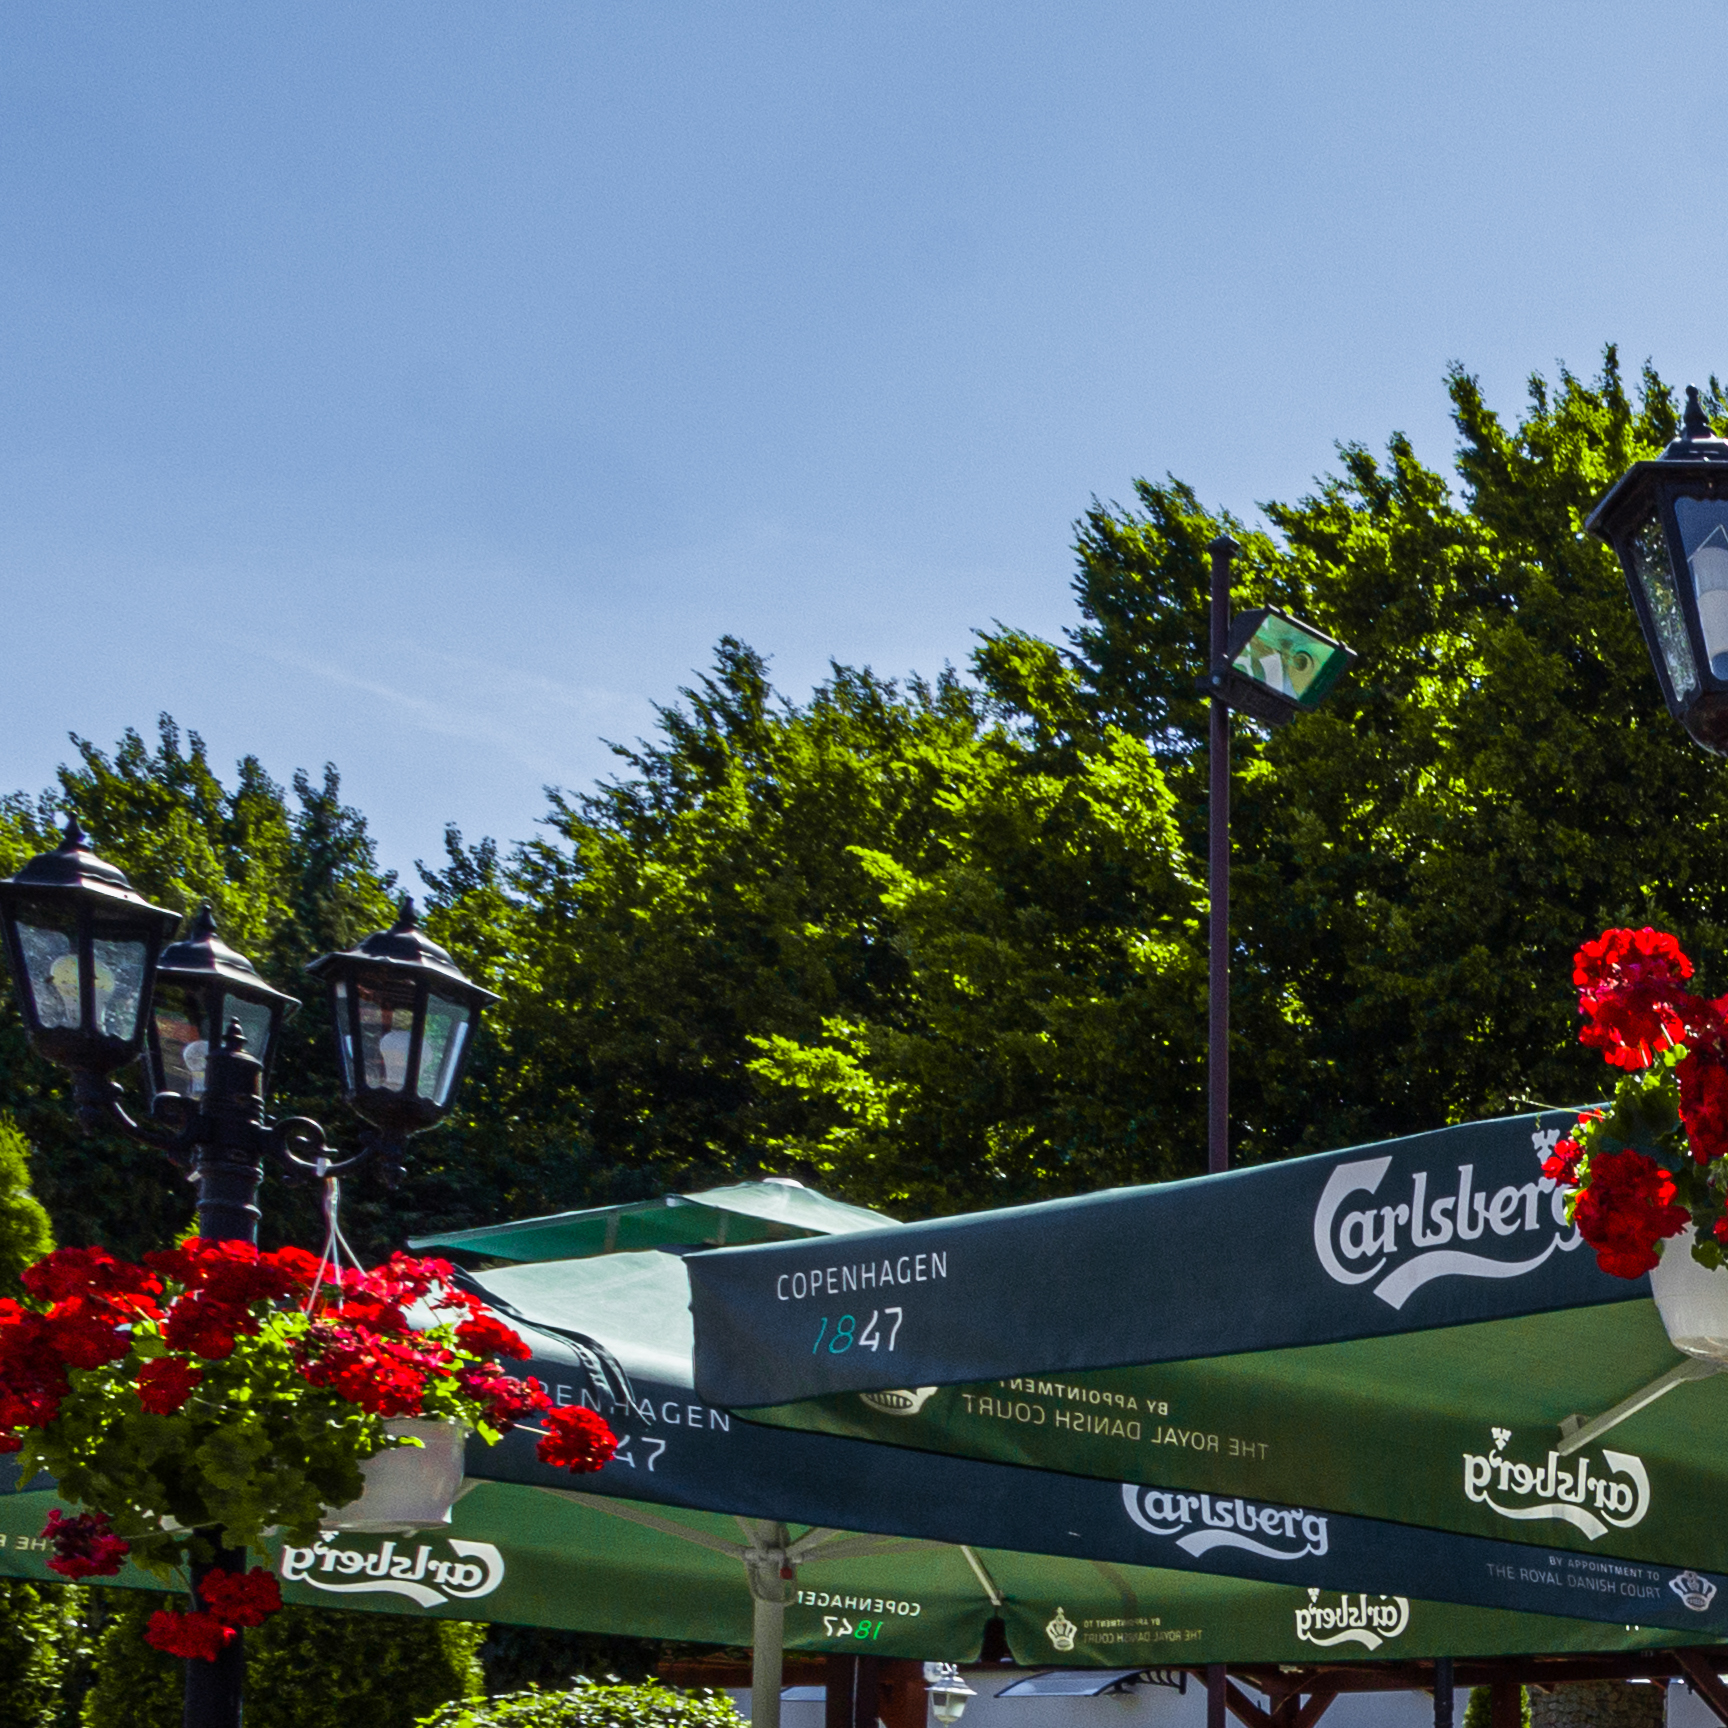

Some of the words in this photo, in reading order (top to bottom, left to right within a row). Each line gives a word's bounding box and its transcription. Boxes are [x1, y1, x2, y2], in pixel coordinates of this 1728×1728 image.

[776, 1250, 948, 1301] COPENHAGEN
[811, 1306, 903, 1355] 1847
[1121, 1483, 1329, 1561] Carlsberg
[1486, 1563, 1516, 1580] THE
[1519, 1568, 1563, 1586] ROYAL
[1566, 1574, 1616, 1594] DANISH
[1619, 1582, 1662, 1599] COURT
[1548, 1555, 1563, 1567] BY
[1567, 1558, 1644, 1579] APPOINTMENT
[1646, 1570, 1660, 1582] TO
